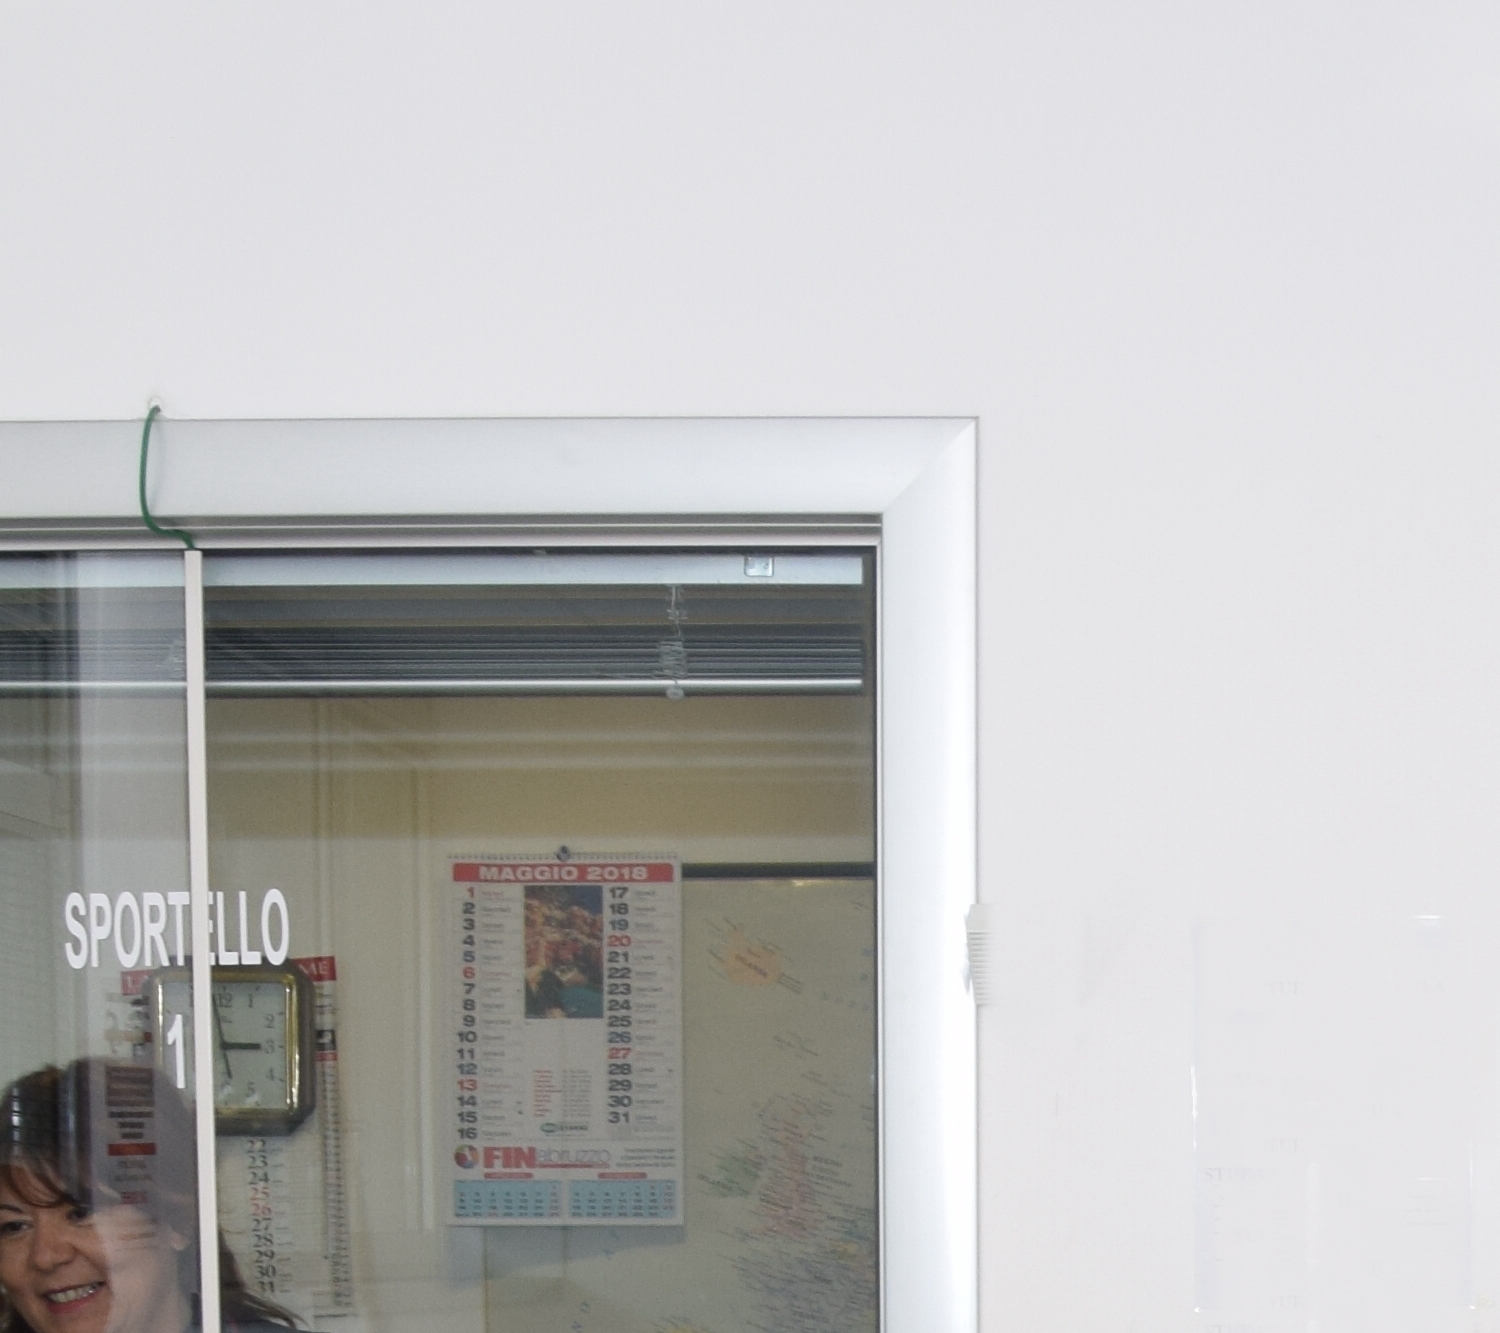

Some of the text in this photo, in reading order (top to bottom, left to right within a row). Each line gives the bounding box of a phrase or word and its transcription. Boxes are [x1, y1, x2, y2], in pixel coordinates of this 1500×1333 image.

[479, 863, 649, 881] MAGGIO 2018
[467, 887, 474, 898] 1
[609, 887, 628, 898] 17
[463, 902, 475, 914] 2
[609, 903, 628, 915] 18
[463, 918, 475, 931] 3
[609, 919, 628, 931] 19
[463, 935, 475, 946] 4
[608, 935, 631, 947] 20
[463, 950, 475, 963] 5
[607, 951, 628, 963] 21
[463, 966, 475, 979] 6
[608, 967, 631, 979] 22
[463, 983, 475, 994] 7
[608, 983, 631, 996] 23
[463, 999, 475, 1011] 8
[608, 999, 631, 1011] 24
[463, 1015, 475, 1027] 9
[608, 1015, 632, 1028] 25
[457, 1031, 477, 1043] 10
[608, 1032, 631, 1044] 26
[167, 1014, 186, 1088] 1
[457, 1048, 474, 1059] 11
[608, 1047, 631, 1060] 27
[457, 1063, 477, 1075] 12
[609, 1063, 631, 1076] 28
[457, 1079, 477, 1091] 13
[609, 1079, 632, 1092] 29
[457, 1096, 477, 1107] 14
[608, 1096, 632, 1108] 30
[458, 1111, 477, 1123] 15
[609, 1111, 629, 1123] 31
[458, 1127, 477, 1139] 16
